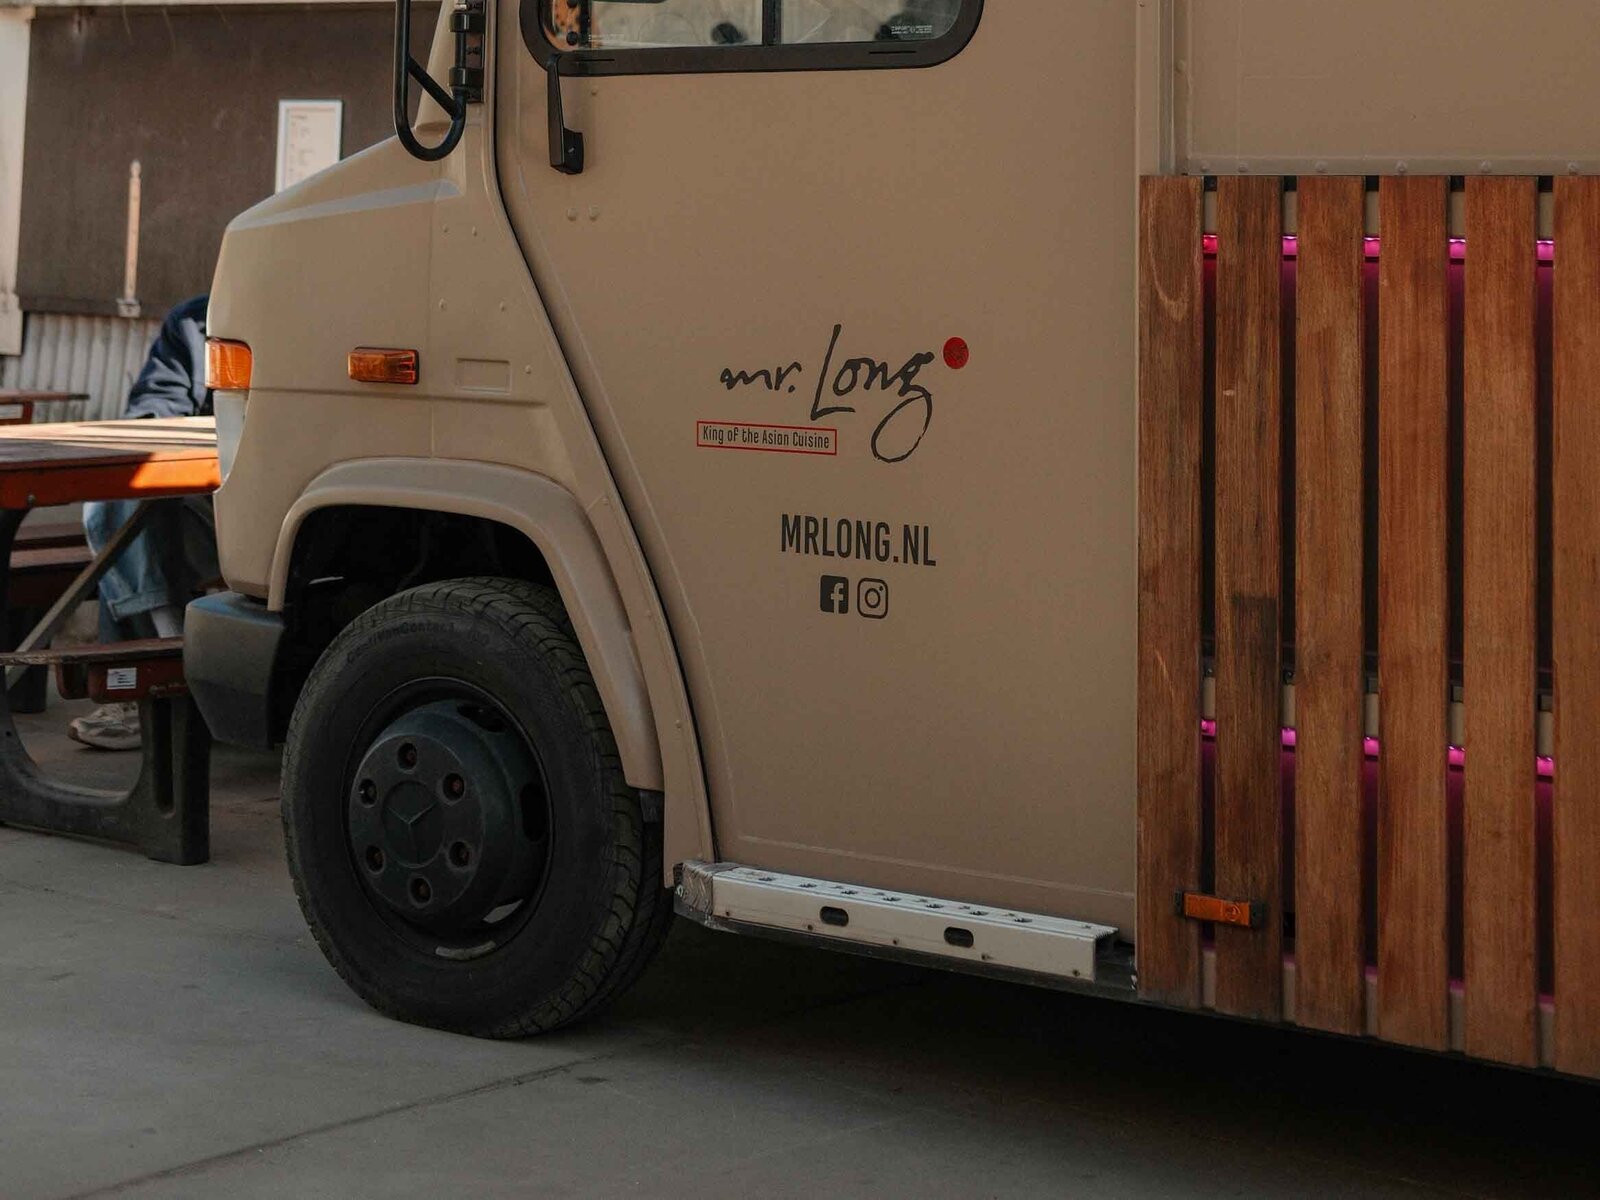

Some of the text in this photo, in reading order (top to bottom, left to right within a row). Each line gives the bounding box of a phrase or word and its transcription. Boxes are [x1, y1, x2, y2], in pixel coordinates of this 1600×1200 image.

[720, 323, 935, 464] mr. Long
[702, 425, 830, 449] King of the Asian Cuisine
[780, 513, 937, 567] MRLONG.NL
